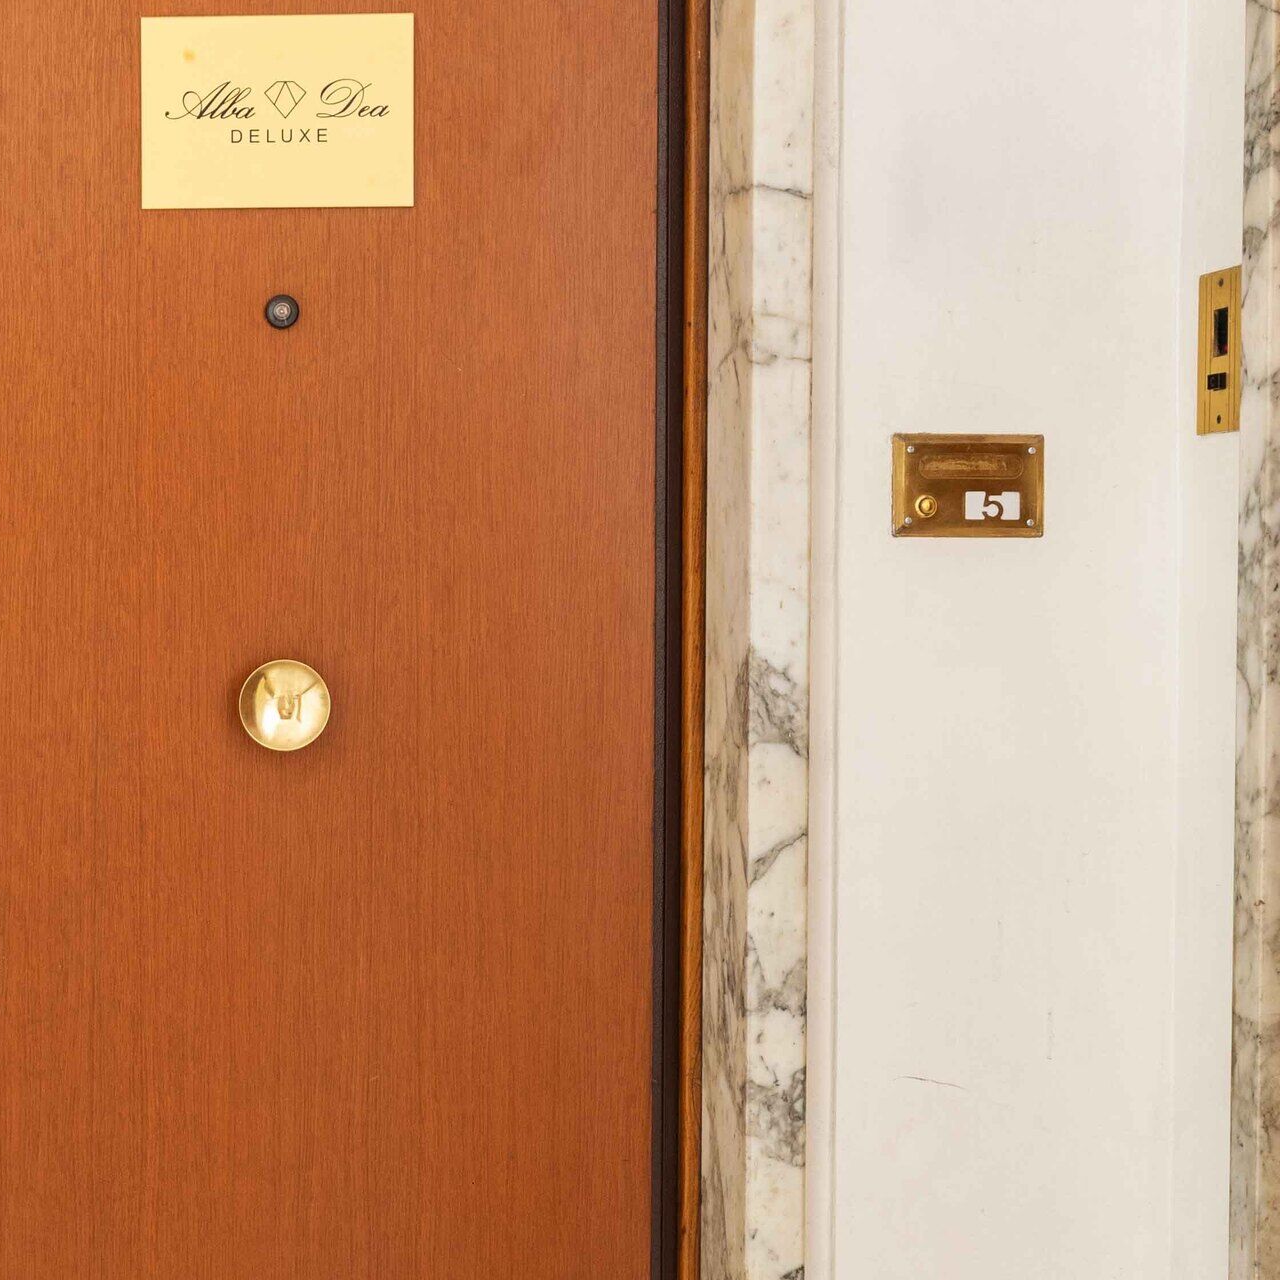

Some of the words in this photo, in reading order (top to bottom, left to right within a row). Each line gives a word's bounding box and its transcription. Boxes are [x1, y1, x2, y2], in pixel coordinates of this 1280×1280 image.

[165, 80, 256, 120] Alba
[316, 78, 390, 119] Dea
[230, 128, 329, 144] DELUXE
[983, 491, 1004, 520] 5
